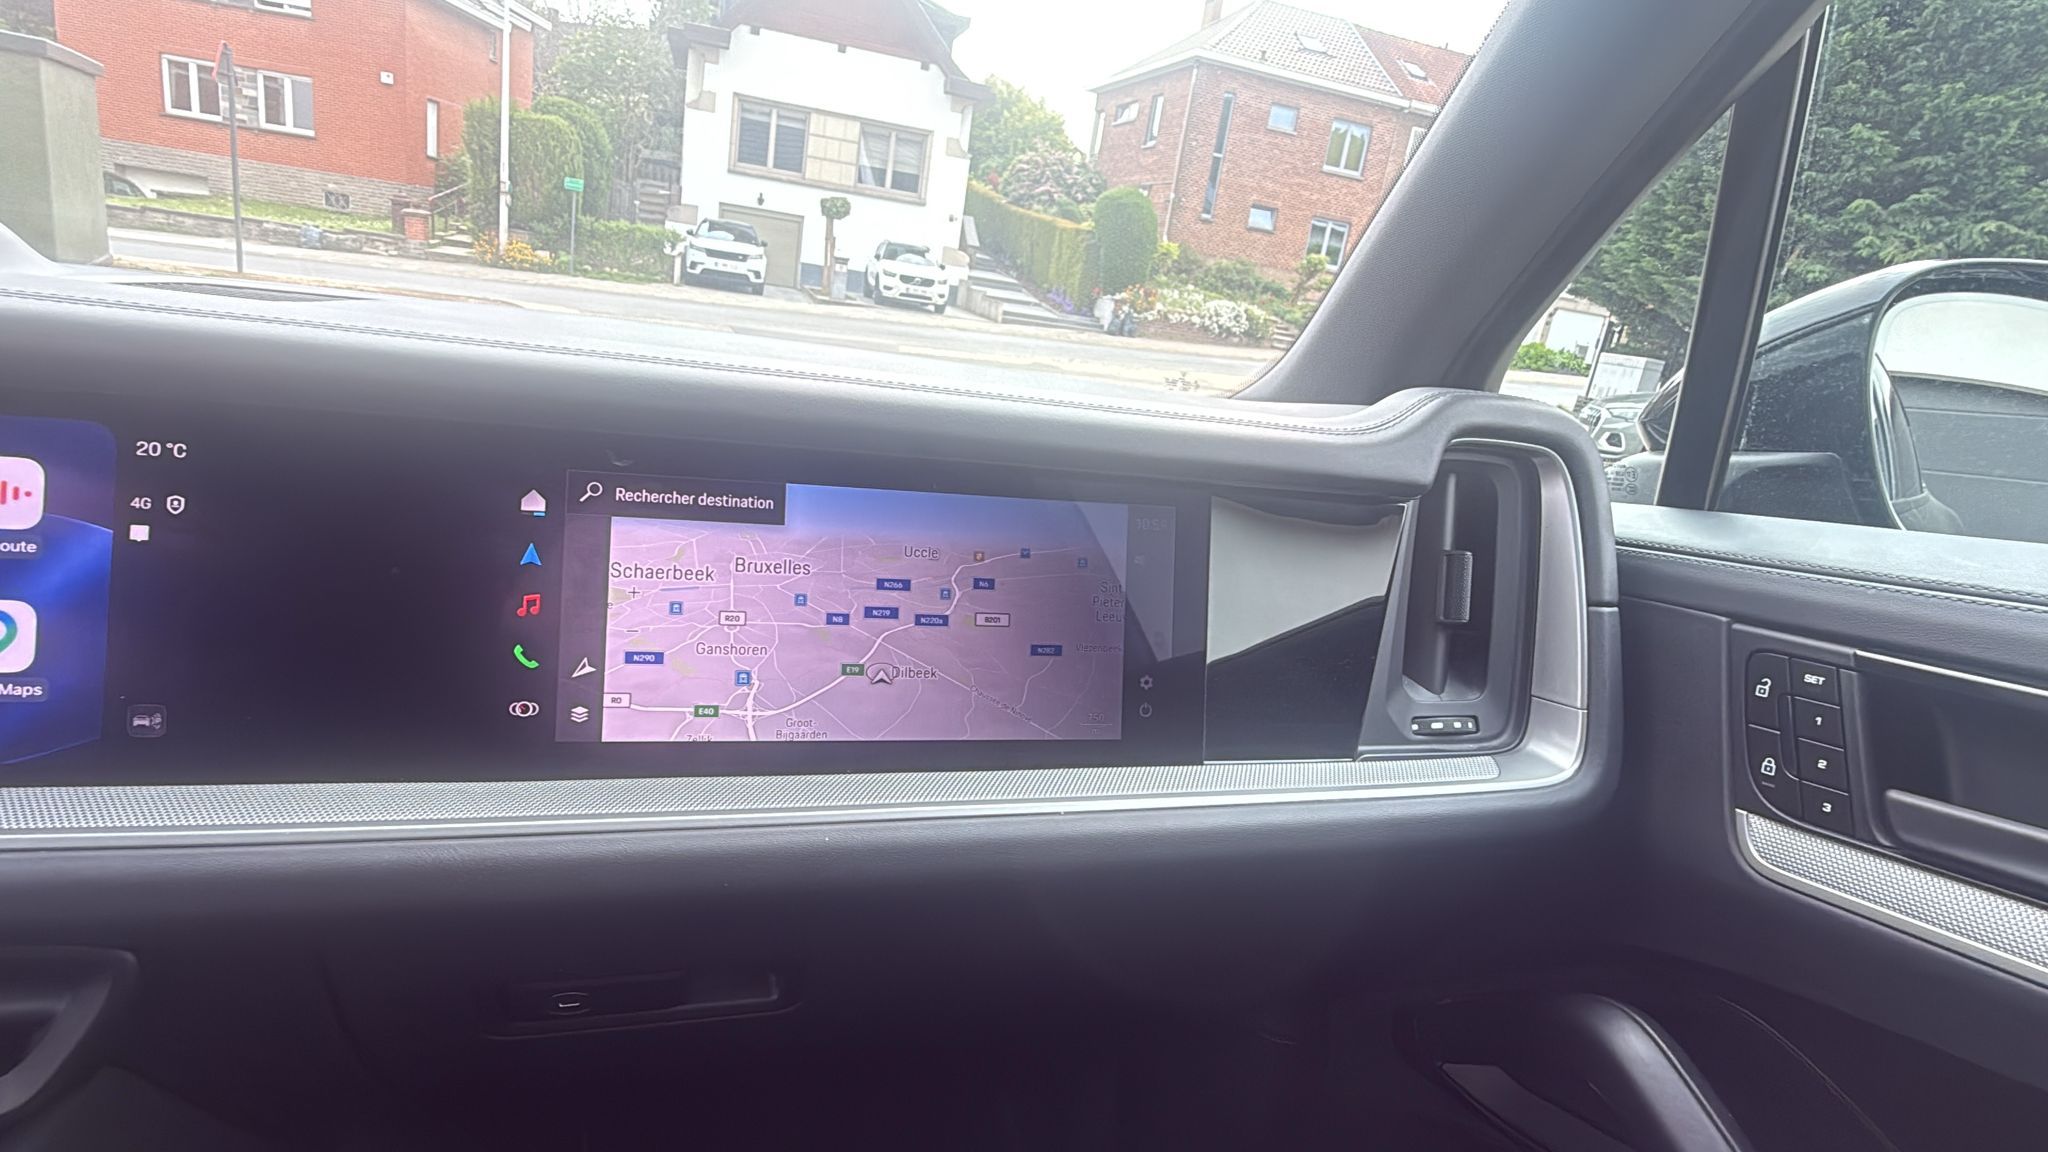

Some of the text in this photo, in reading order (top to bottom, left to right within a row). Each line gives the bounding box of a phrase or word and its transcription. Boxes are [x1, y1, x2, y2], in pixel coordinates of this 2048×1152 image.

[136, 441, 188, 458] 20 °C
[130, 497, 152, 510] 4G
[615, 487, 775, 509] Rechercher destination
[904, 546, 939, 560] Uccle
[610, 562, 715, 582] Schaerbeek
[735, 557, 812, 577] Bruxelles
[884, 581, 903, 589] N266
[1100, 581, 1122, 593] Sint
[724, 614, 740, 623] R20
[695, 642, 768, 657] Ganshoren
[633, 654, 655, 663] N290
[892, 665, 938, 679] Dilbeek
[1803, 673, 1826, 686] SET
[0, 683, 43, 698] Maps
[698, 707, 714, 715] E40
[785, 717, 817, 728] Groot-
[1815, 716, 1823, 726] 1
[775, 729, 828, 741] Bijgaarden
[1817, 759, 1828, 770] 2
[1821, 802, 1832, 813] 3
